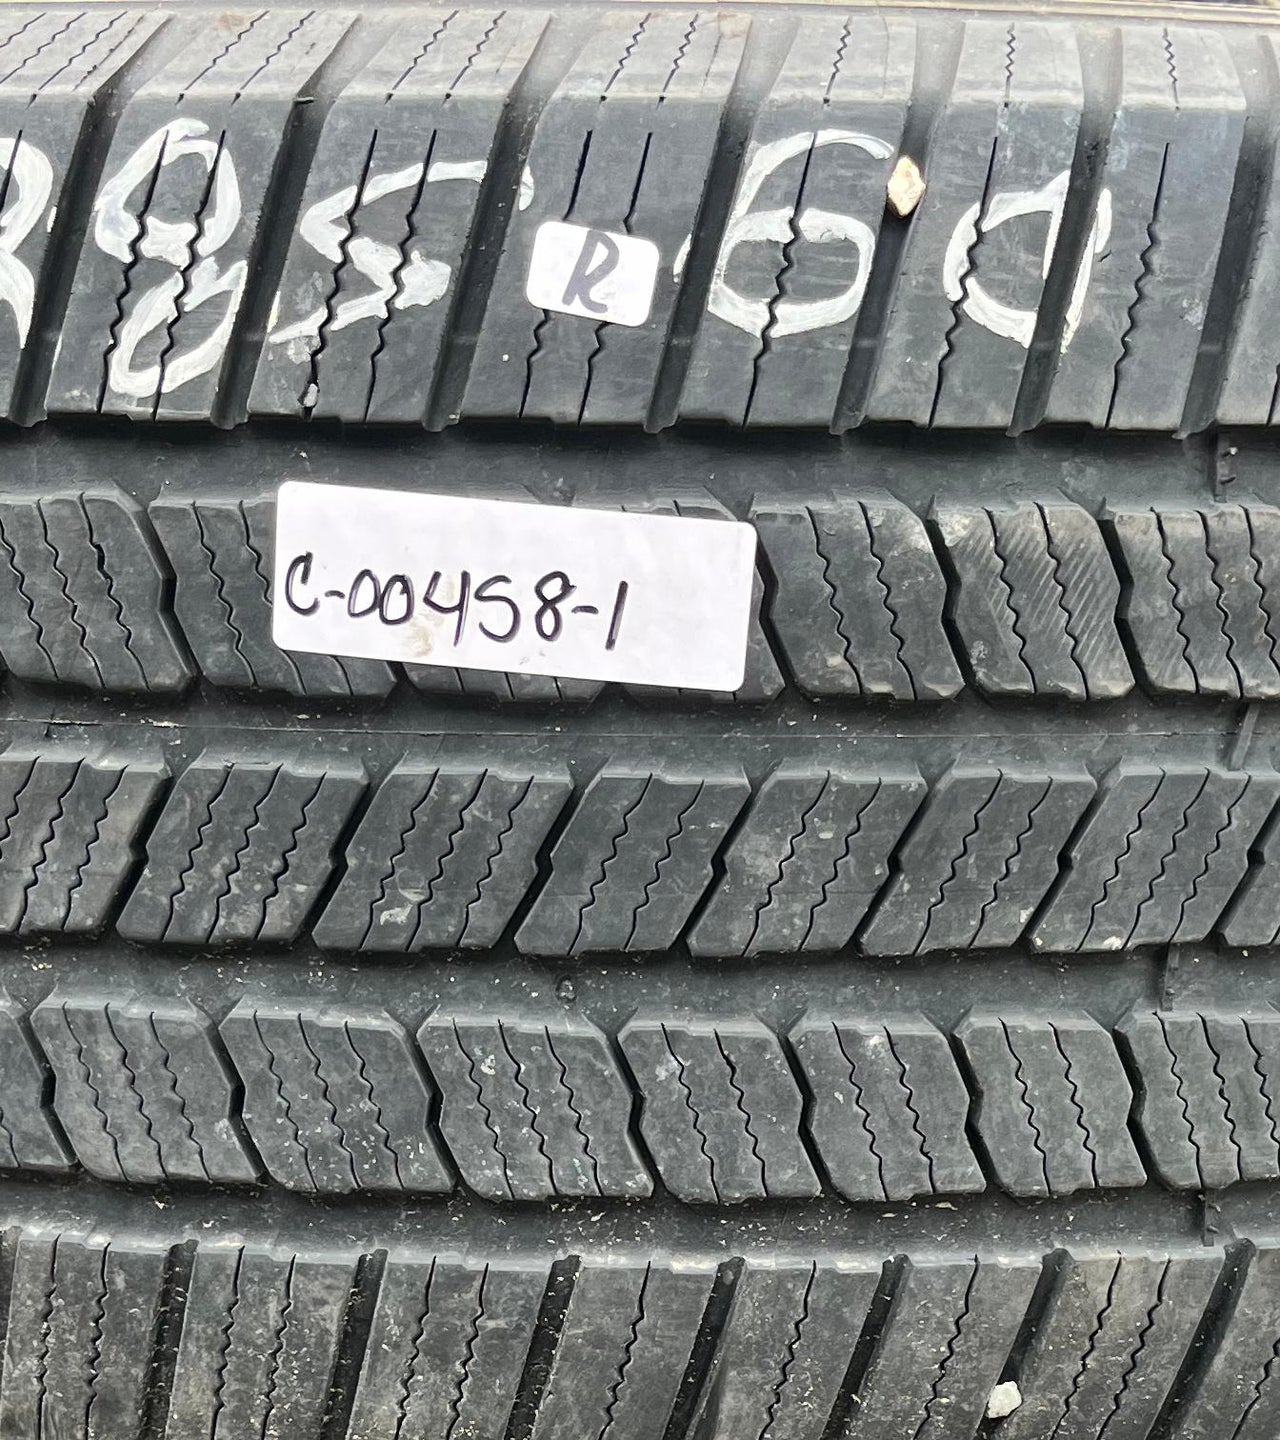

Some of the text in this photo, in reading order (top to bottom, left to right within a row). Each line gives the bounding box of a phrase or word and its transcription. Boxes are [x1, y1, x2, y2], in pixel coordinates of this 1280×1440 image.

[561, 229, 619, 314] R
[672, 128, 1113, 352] 60
[285, 552, 628, 651] C-00458-1
